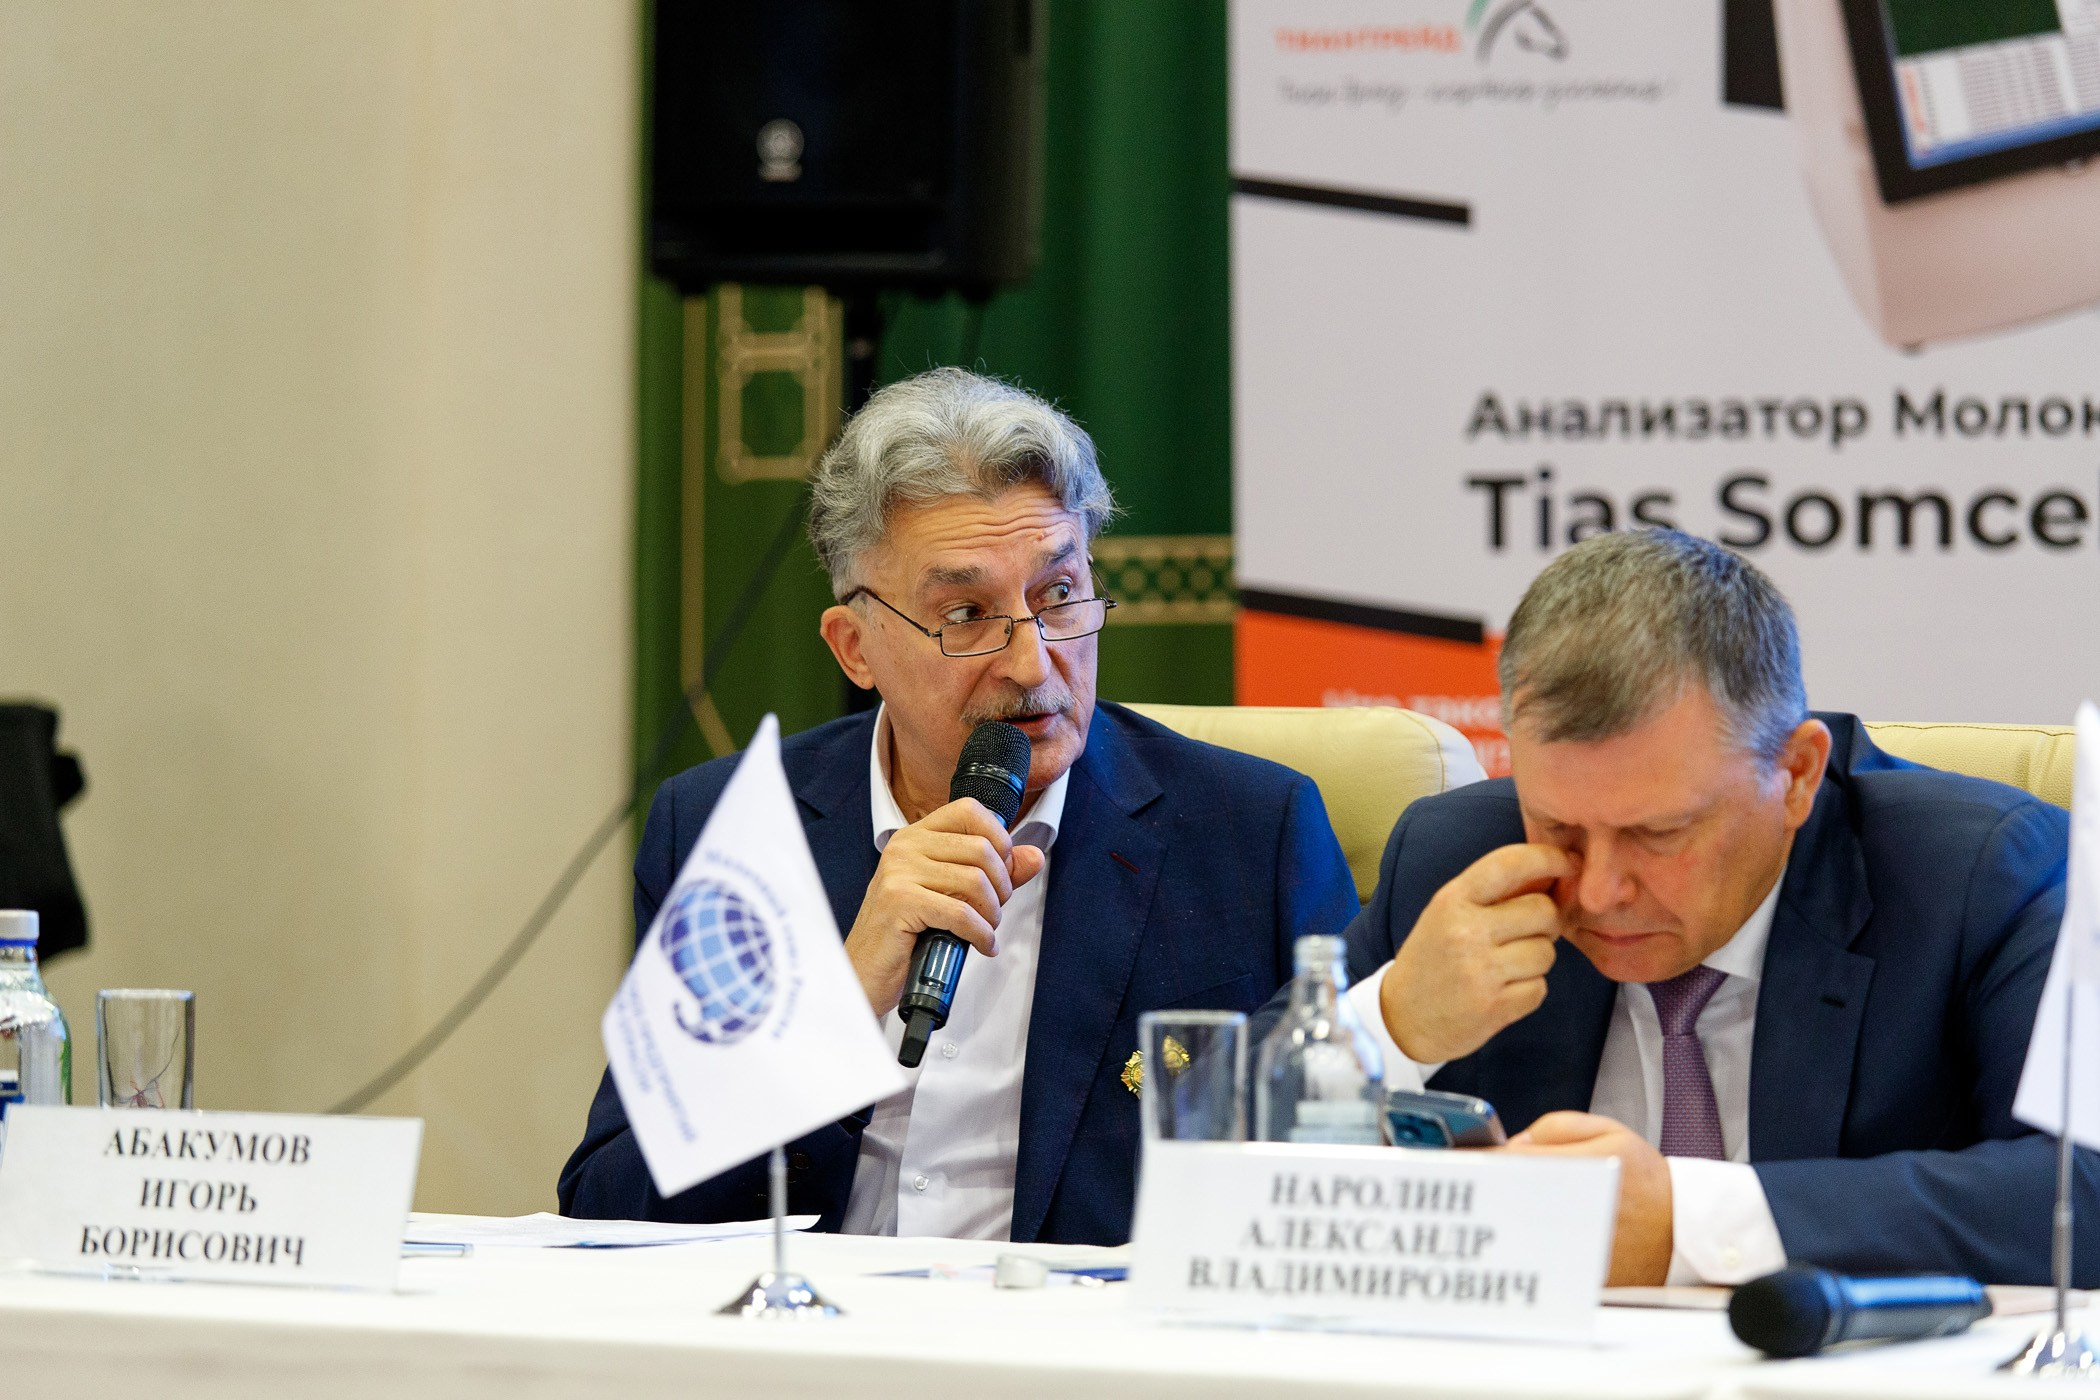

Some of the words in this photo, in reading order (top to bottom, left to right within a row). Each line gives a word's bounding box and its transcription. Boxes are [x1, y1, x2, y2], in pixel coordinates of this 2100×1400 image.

[1467, 391, 1868, 448] Анализатор
[1465, 463, 1676, 550] Tias
[1717, 472, 2100, 549] Somce
[104, 1127, 311, 1164] АБАКУМОВ
[139, 1178, 258, 1212] ИГОРЬ
[1270, 1173, 1475, 1214] НАРОЛИН
[80, 1225, 305, 1266] БОРИСОВИЧ
[1242, 1219, 1494, 1262] АЛЕКСАНДР
[1187, 1257, 1539, 1306] ВЛАДИМИРОВИЧ
